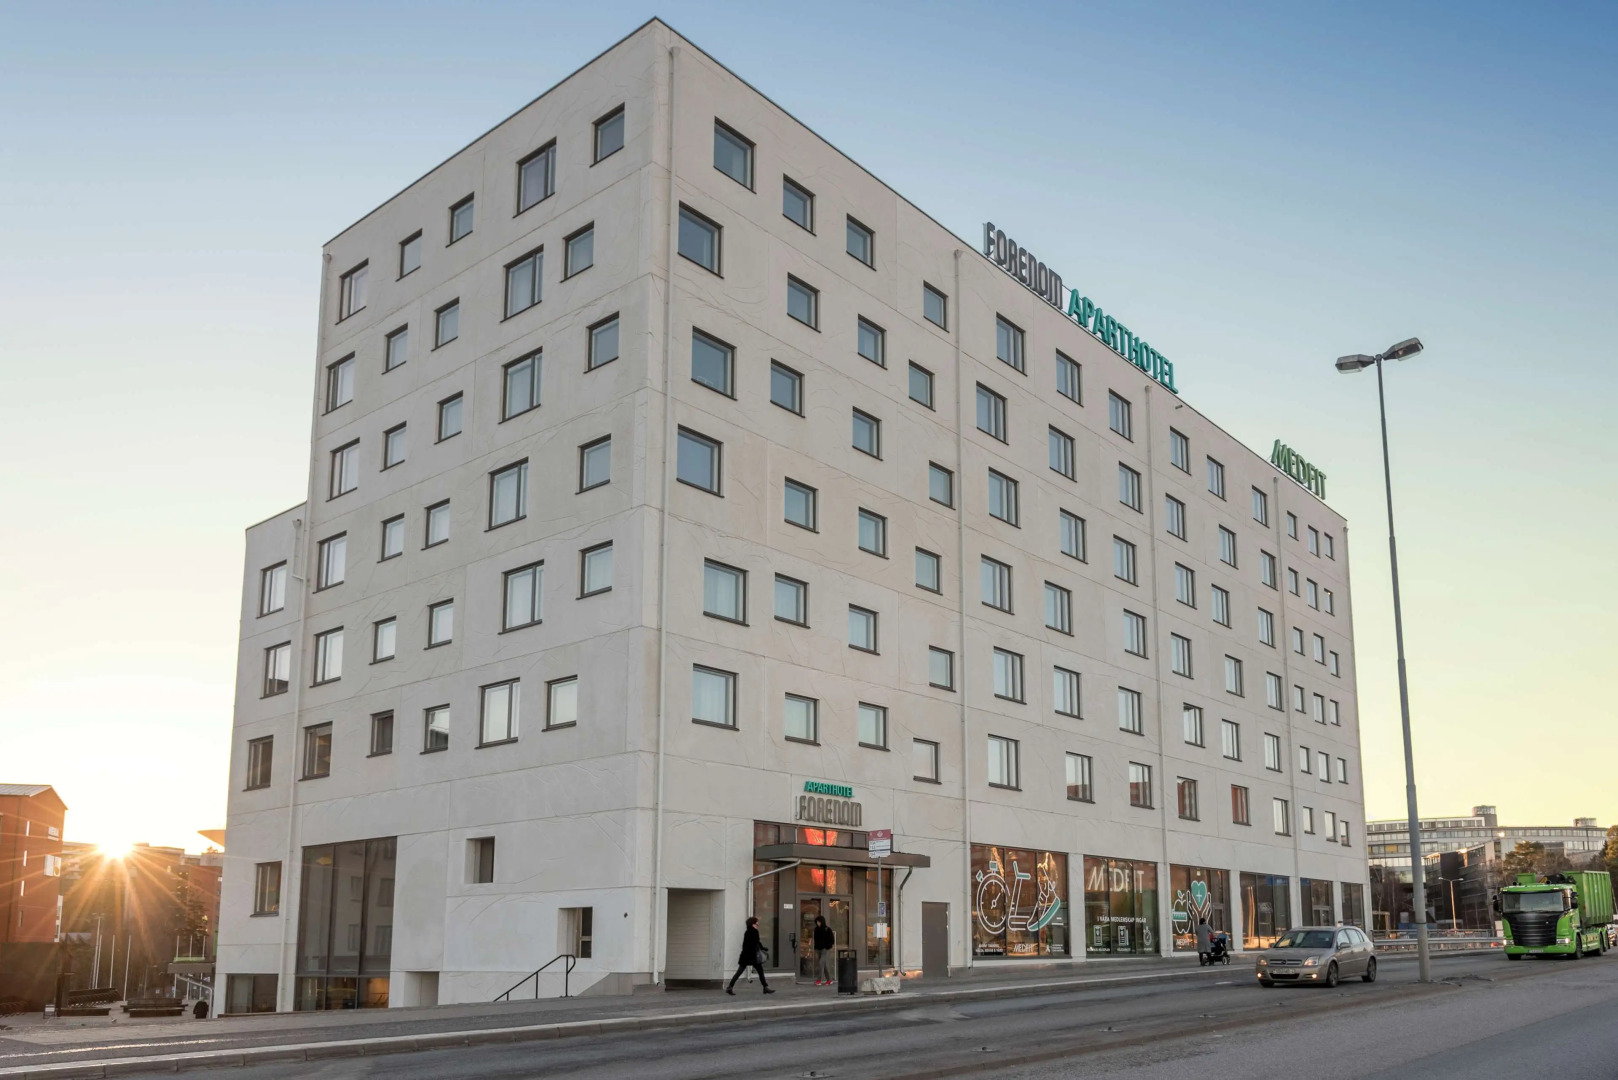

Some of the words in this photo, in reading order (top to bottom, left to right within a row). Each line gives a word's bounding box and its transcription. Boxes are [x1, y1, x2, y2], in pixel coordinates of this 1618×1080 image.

[983, 222, 1063, 310] FORENOM
[1068, 289, 1178, 394] APARTHOTEL
[1271, 439, 1327, 500] MEDFIT
[799, 795, 863, 827] FORENOM
[804, 781, 855, 798] APARTHOTEL
